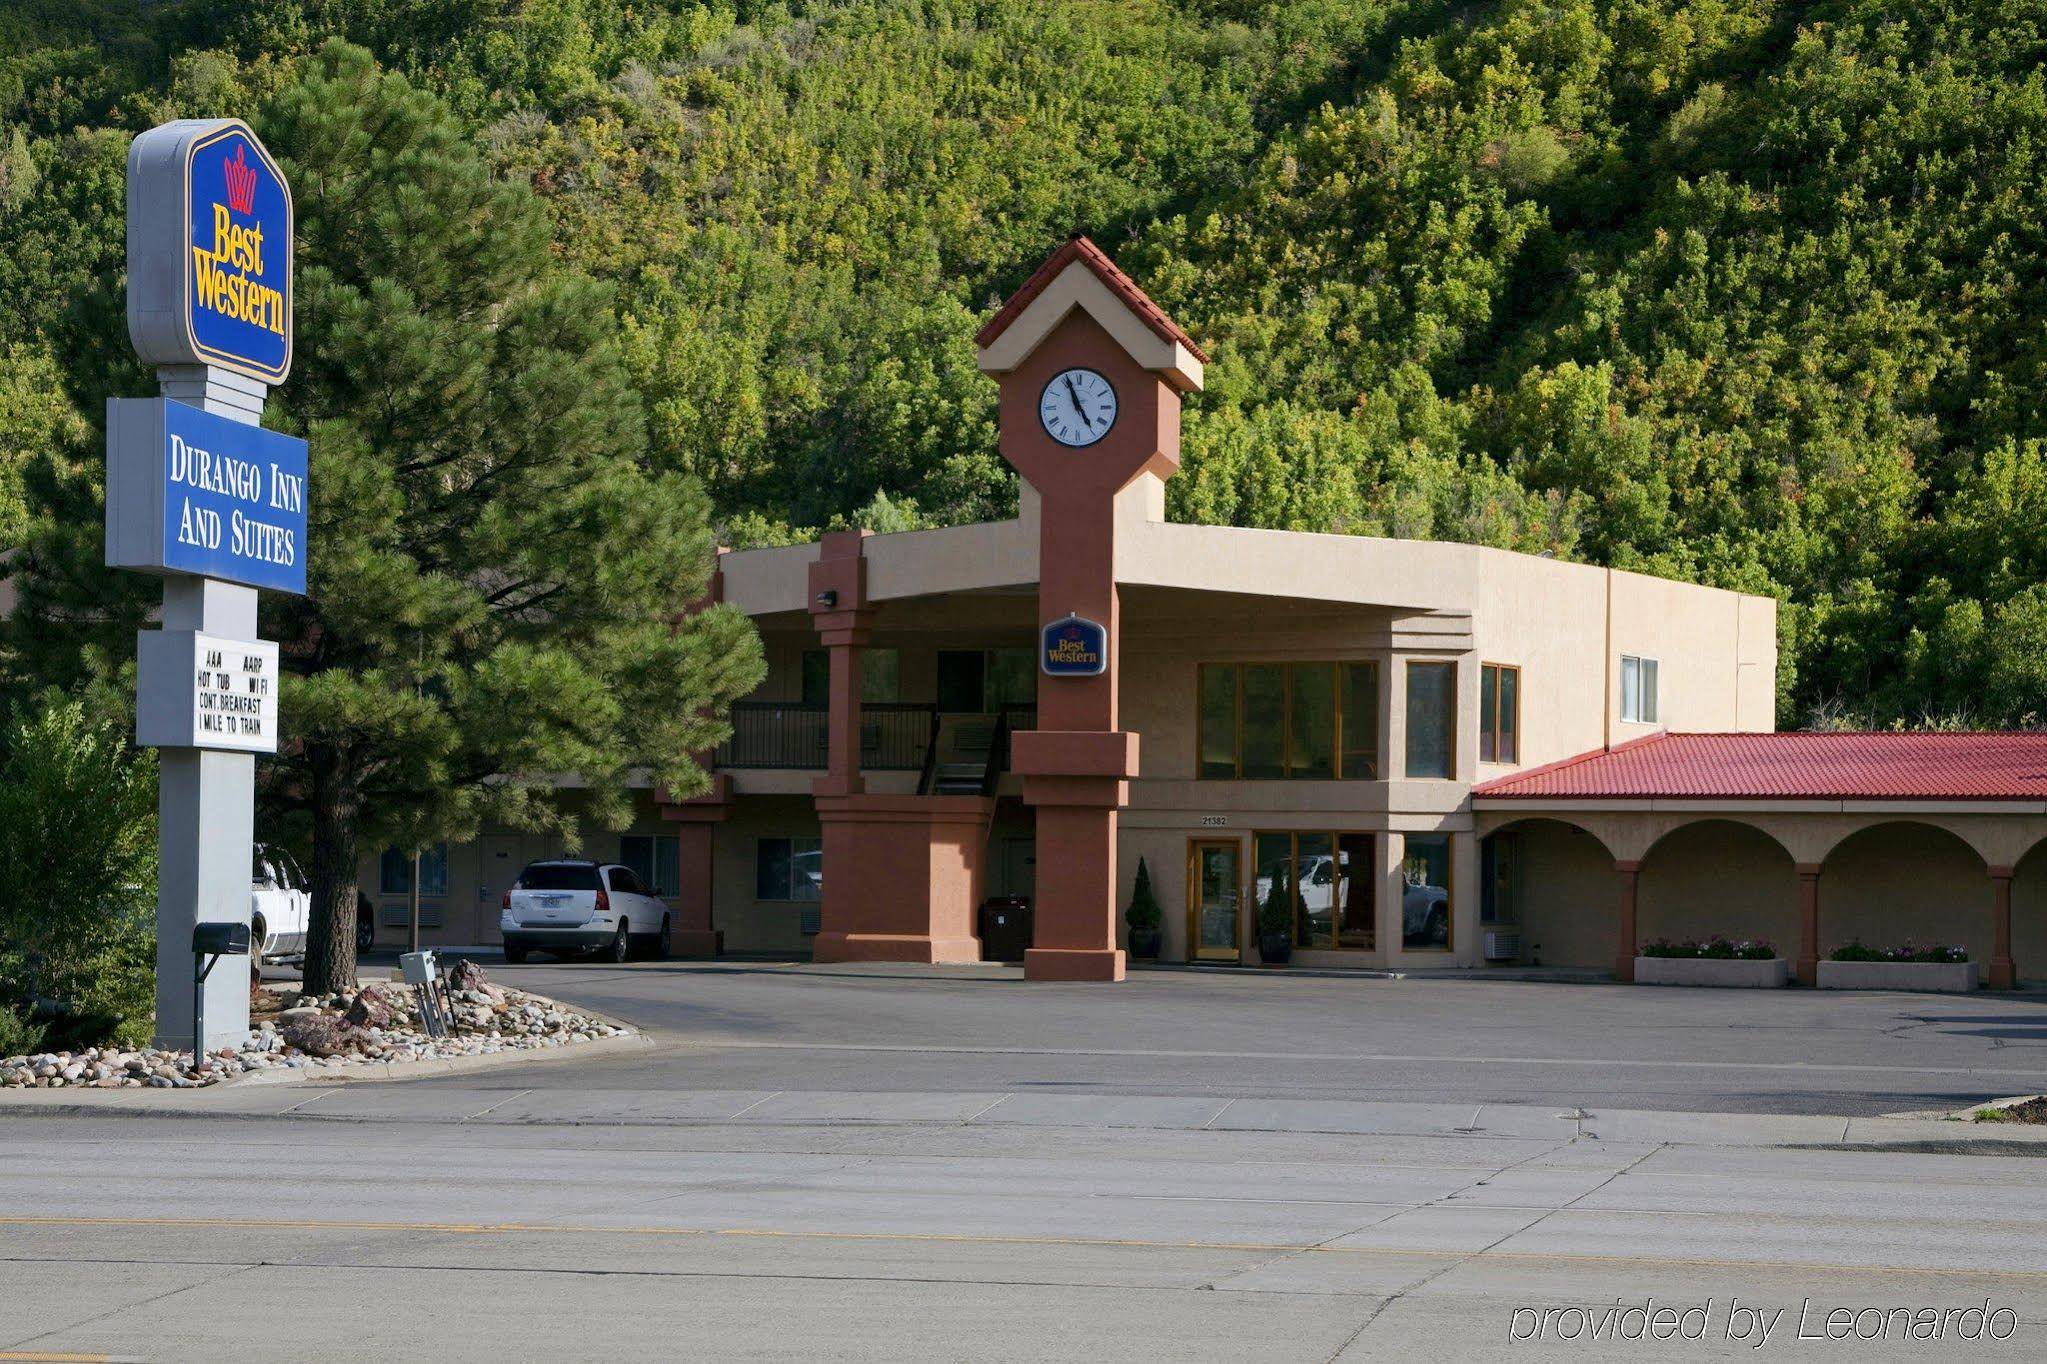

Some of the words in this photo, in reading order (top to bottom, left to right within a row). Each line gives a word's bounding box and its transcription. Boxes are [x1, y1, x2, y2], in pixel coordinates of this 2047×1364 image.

[213, 203, 264, 276] Best
[193, 246, 285, 335] Western
[170, 433, 261, 503] DURANGO
[270, 462, 303, 514] INN
[178, 496, 221, 549] AND
[231, 509, 294, 567] SUITES
[1048, 649, 1097, 663] Western
[1059, 639, 1086, 652] Best
[206, 651, 221, 668] AAA
[243, 656, 263, 673] AARP
[198, 671, 211, 687] HOT
[216, 673, 230, 690] TUB
[204, 714, 223, 732] MILE
[226, 716, 237, 733] TO
[240, 717, 261, 735] TRAIN
